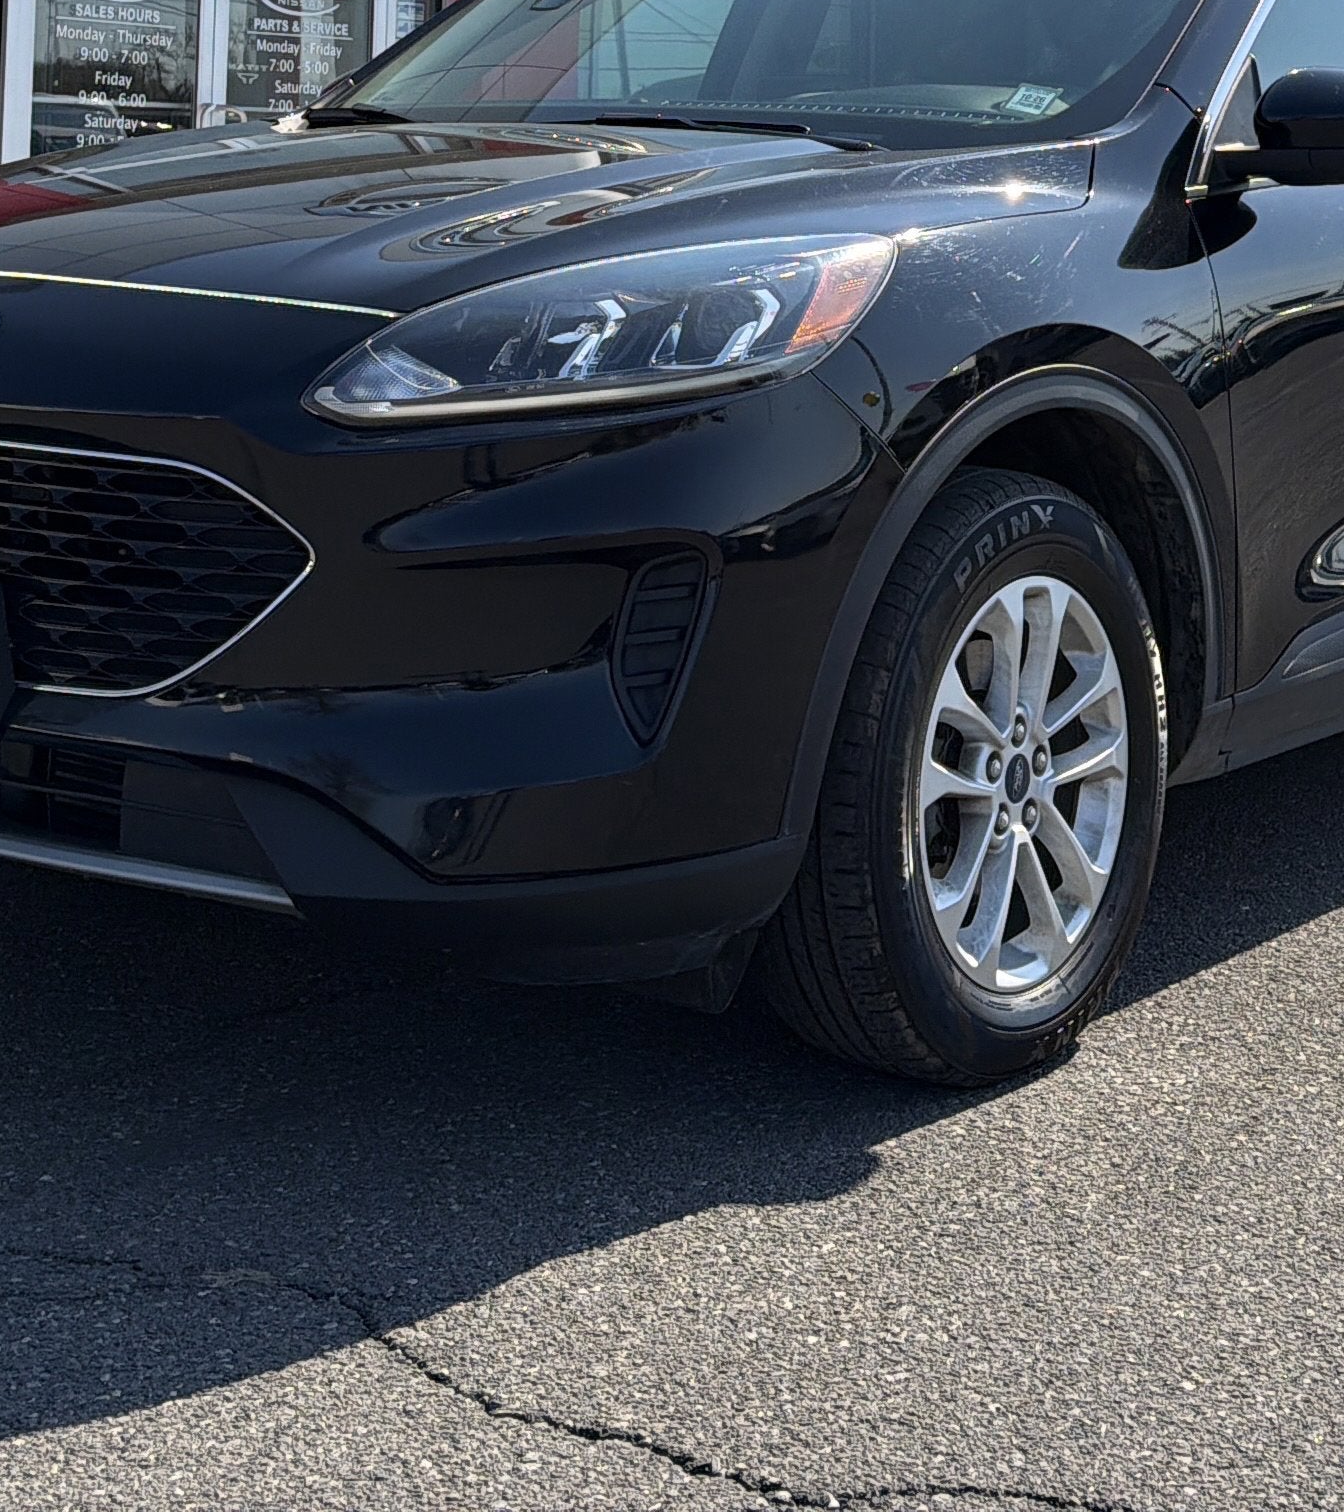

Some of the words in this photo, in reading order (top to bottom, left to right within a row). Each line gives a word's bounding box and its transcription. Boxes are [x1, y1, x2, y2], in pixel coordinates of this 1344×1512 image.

[75, 3, 115, 20] SALES
[118, 7, 161, 23] HOURS
[254, 18, 289, 32] PARTS
[292, 21, 301, 33] &
[304, 22, 349, 36] SERVICE
[56, 24, 106, 44] Monday
[117, 29, 173, 49] Thursday
[80, 47, 109, 62] 9:00
[121, 50, 148, 65] 7:00
[256, 39, 300, 56] Monday
[310, 42, 342, 59] Friday
[269, 59, 294, 73] 7:00
[304, 61, 329, 75] 5:00
[95, 71, 132, 89] Friday
[275, 80, 322, 97] Saturday
[78, 90, 106, 105] 9:00
[118, 93, 147, 107] 6:00
[268, 99, 294, 113] 7:00
[84, 114, 138, 133] Saturday
[76, 134, 105, 148] 9:00
[954, 504, 1054, 594] PRINX
